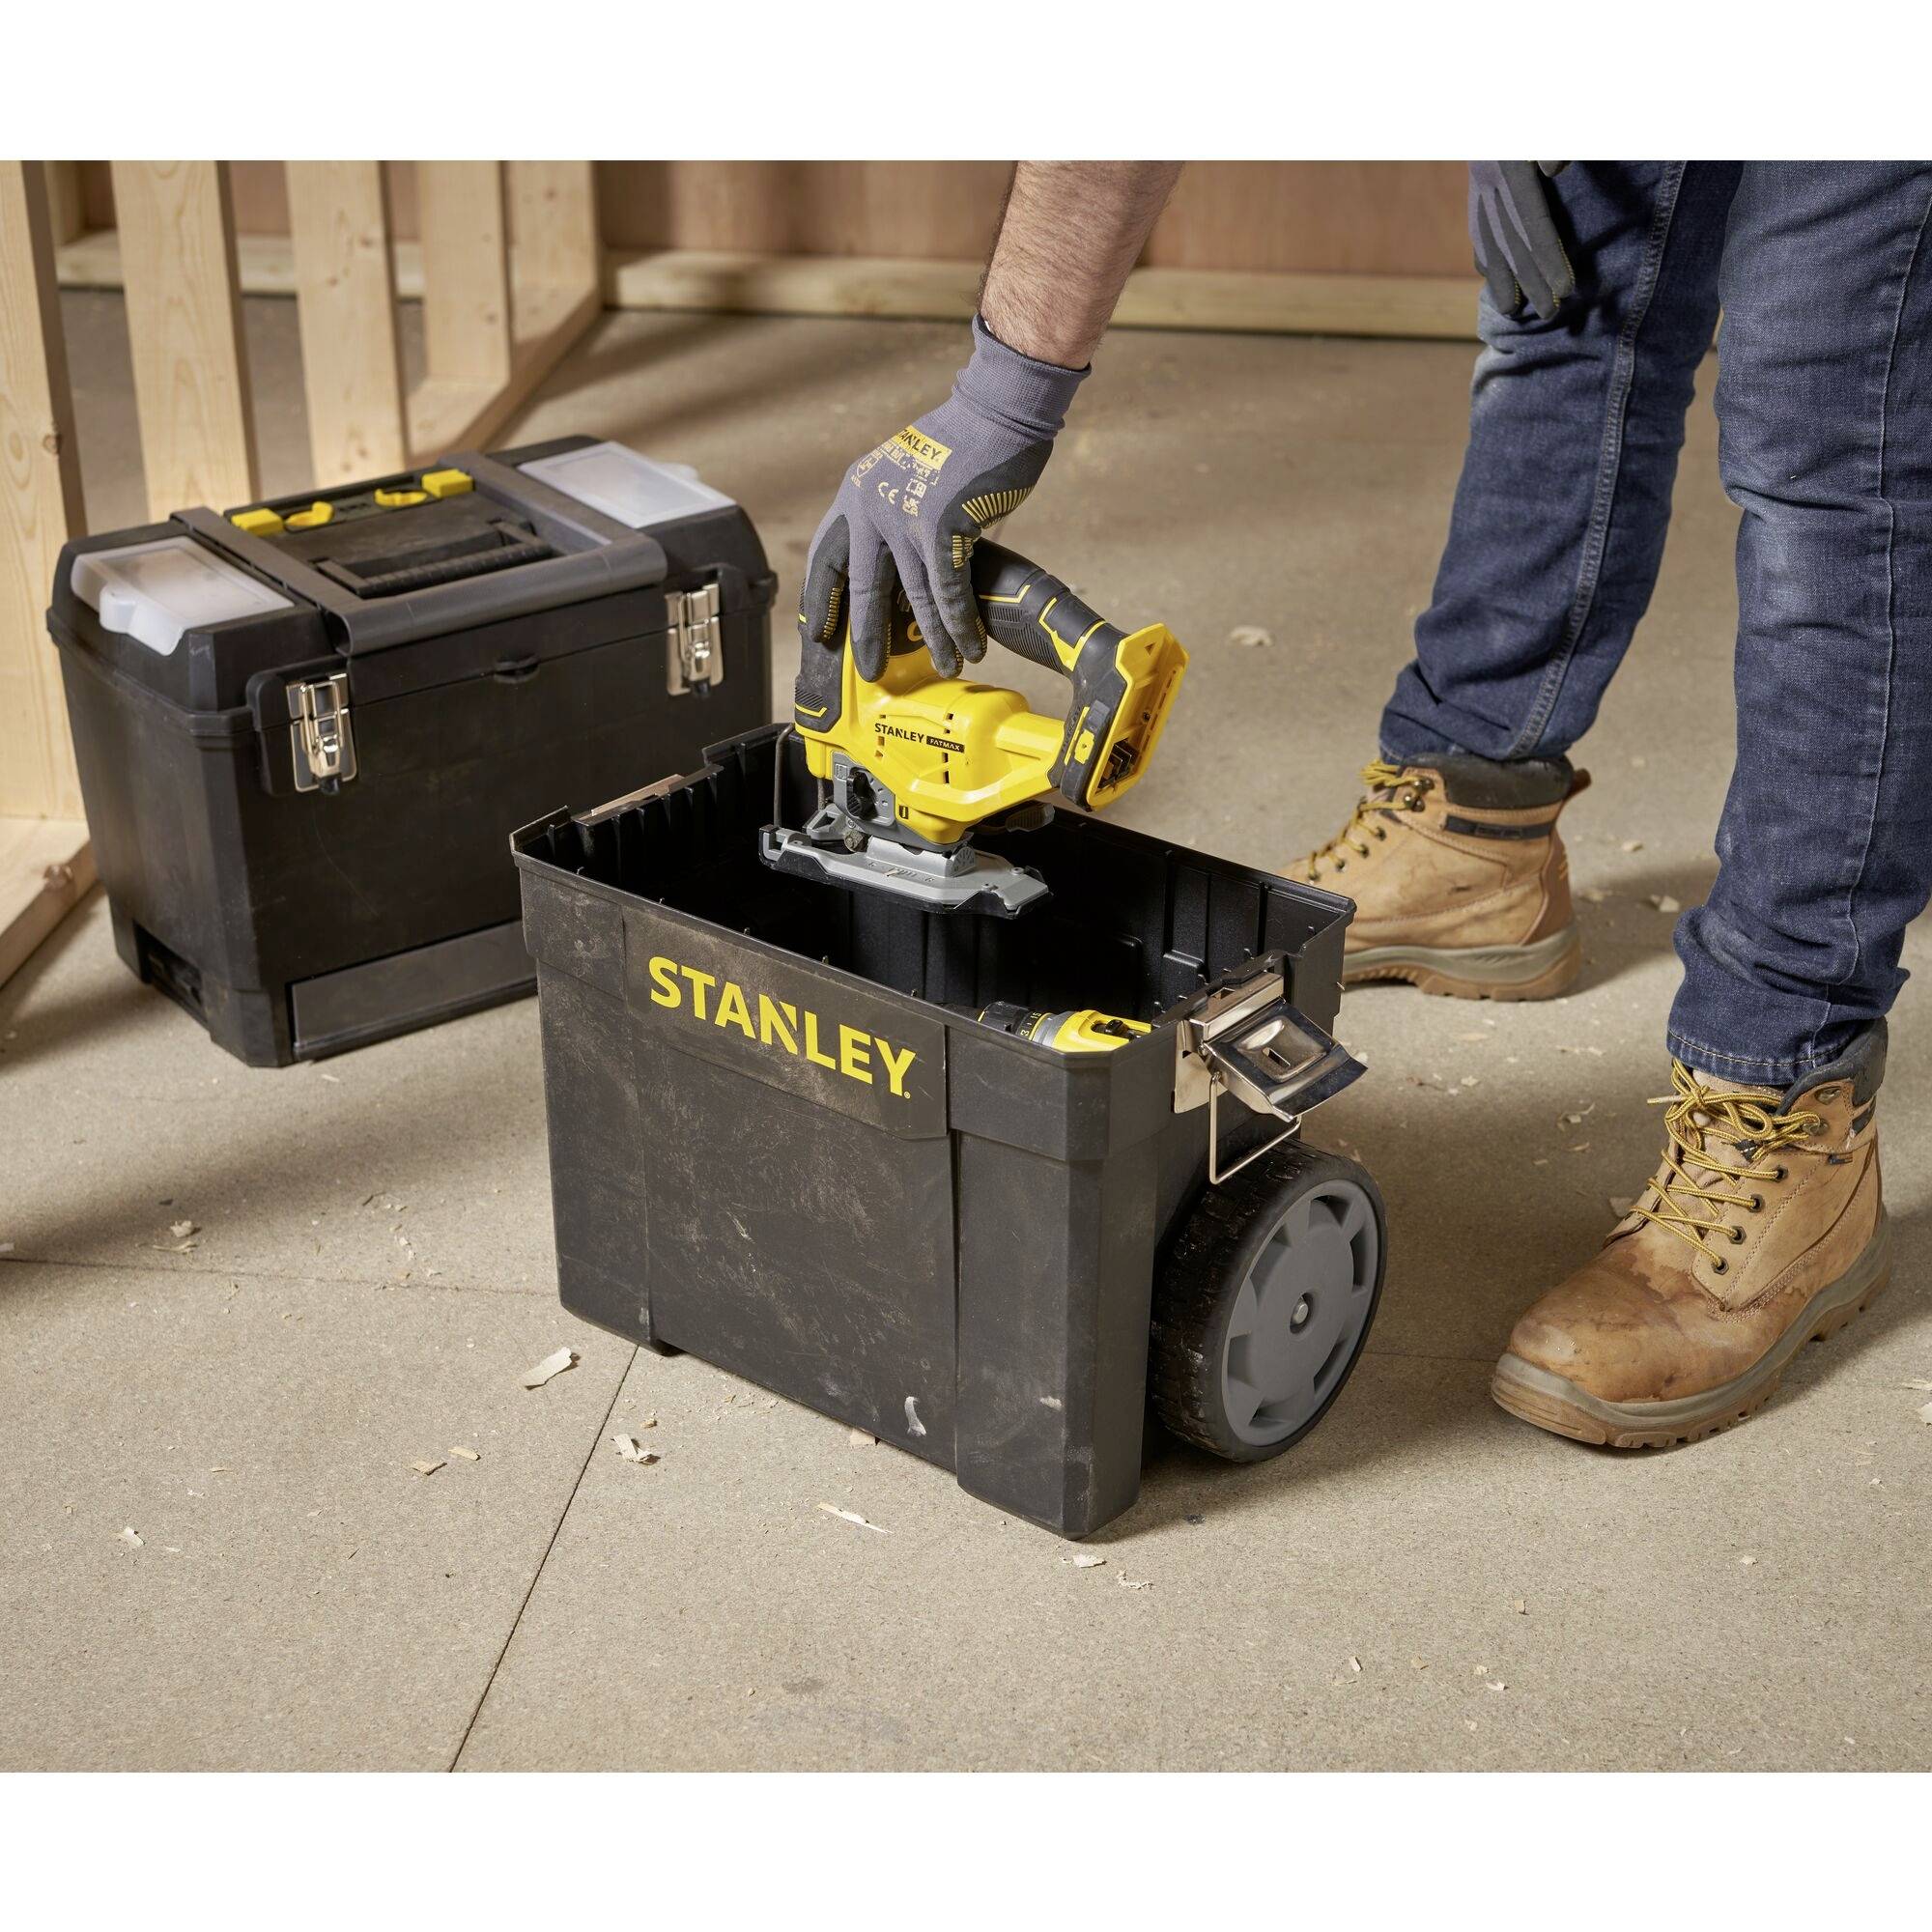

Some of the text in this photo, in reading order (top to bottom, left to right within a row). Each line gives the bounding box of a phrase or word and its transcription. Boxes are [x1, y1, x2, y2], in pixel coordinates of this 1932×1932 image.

[874, 723, 961, 752] STANLEY FATMAX
[648, 955, 917, 1097] STANLEY
